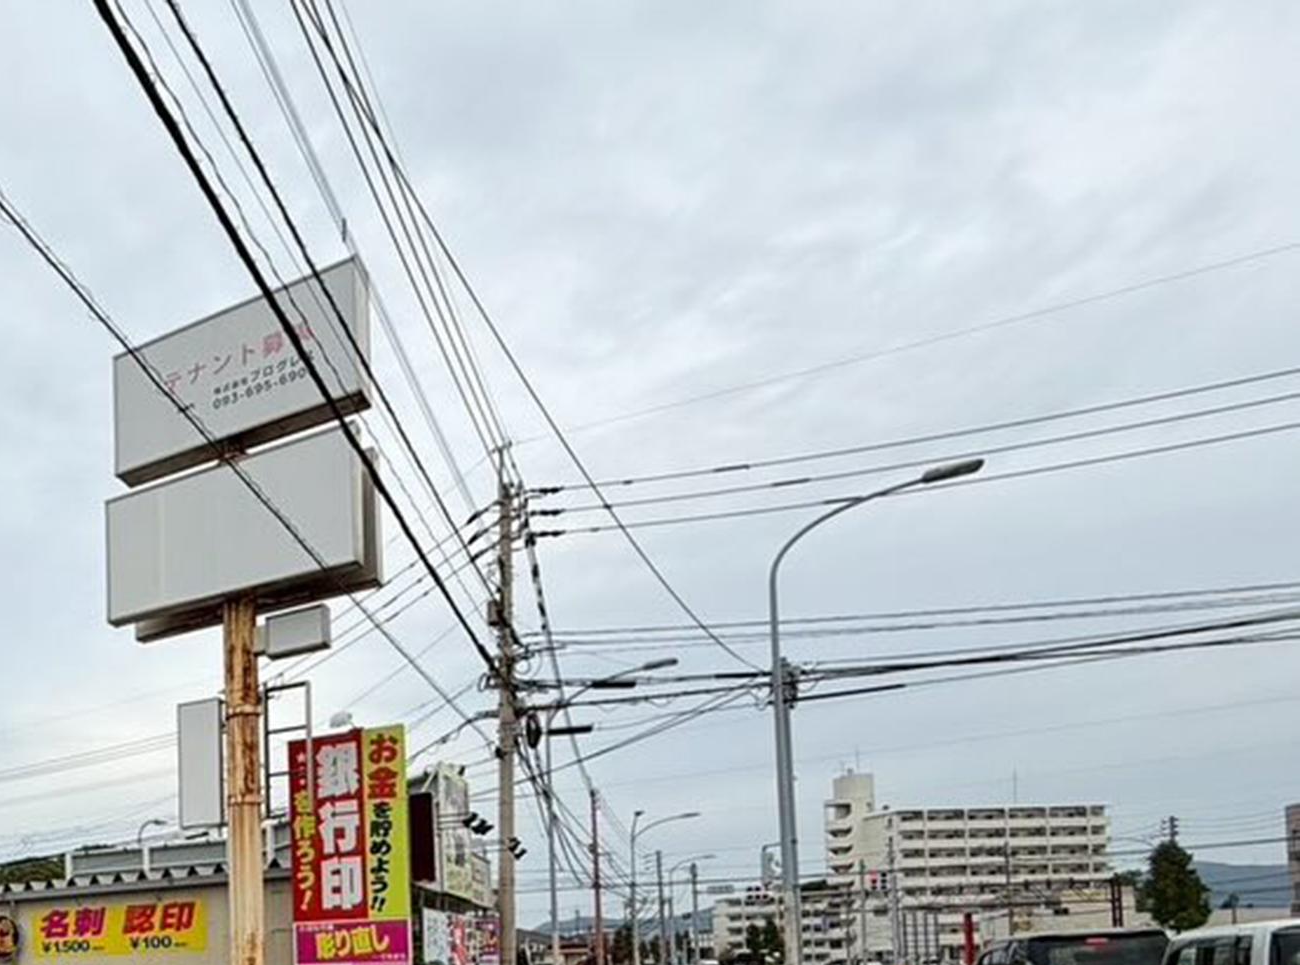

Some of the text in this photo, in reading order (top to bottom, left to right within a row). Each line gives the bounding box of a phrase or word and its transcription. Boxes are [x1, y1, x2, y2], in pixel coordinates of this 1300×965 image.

[212, 364, 316, 410] 093-695-690
[315, 740, 364, 911] 銀行印
[40, 906, 106, 939] 名刺
[123, 901, 196, 935] 認印
